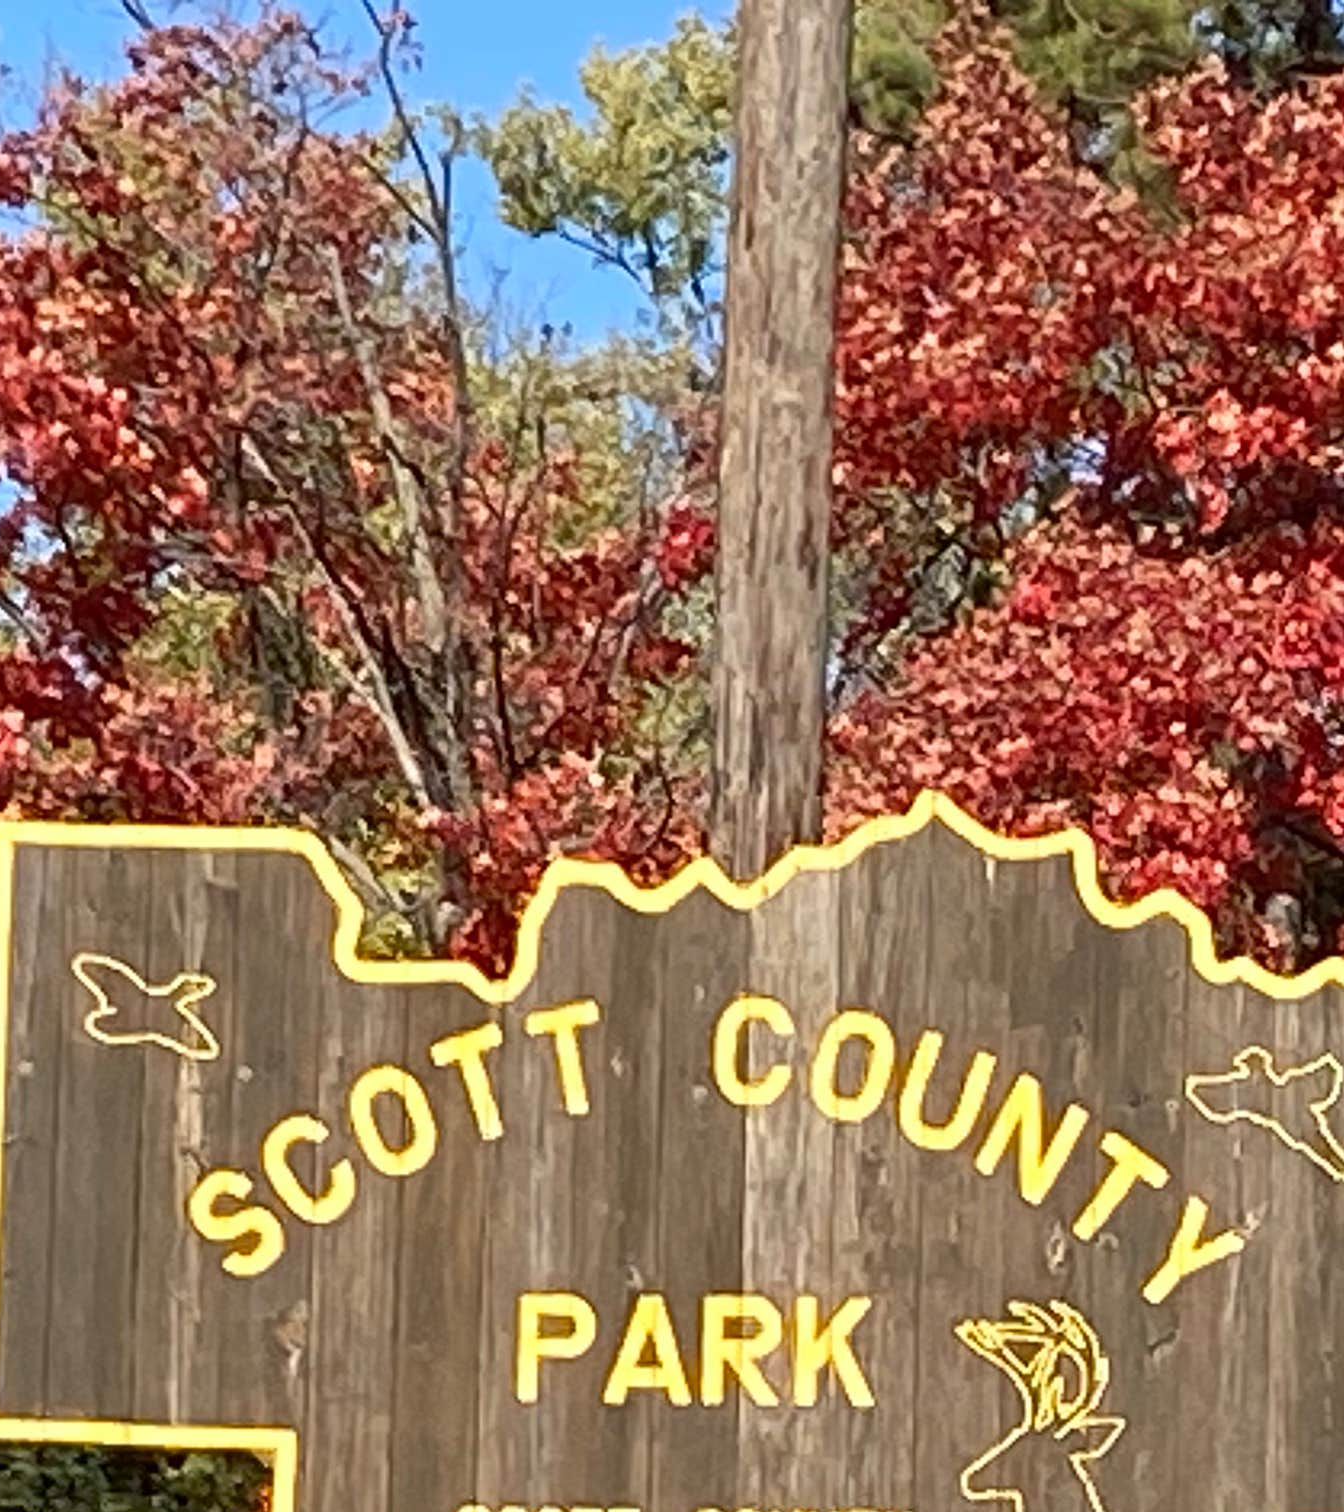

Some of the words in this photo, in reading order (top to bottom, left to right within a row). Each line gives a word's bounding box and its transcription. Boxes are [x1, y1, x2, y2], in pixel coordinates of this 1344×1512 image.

[189, 1002, 599, 1277] SCOTT
[712, 995, 1245, 1304] COUNTY
[516, 1293, 875, 1409] PARK
